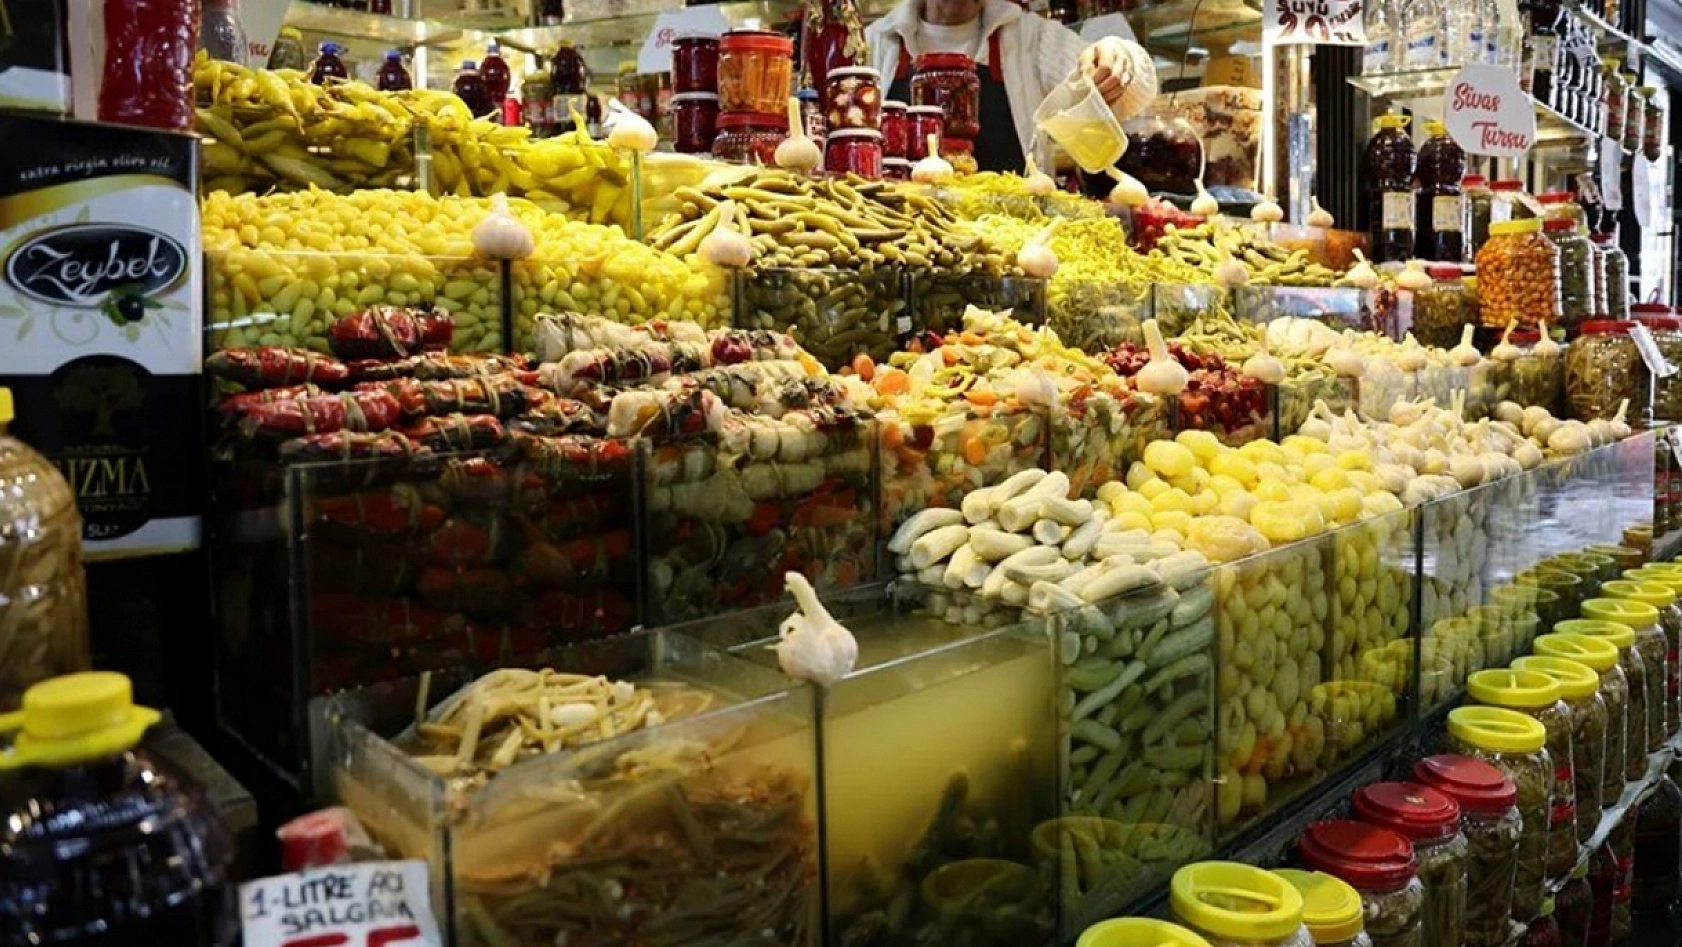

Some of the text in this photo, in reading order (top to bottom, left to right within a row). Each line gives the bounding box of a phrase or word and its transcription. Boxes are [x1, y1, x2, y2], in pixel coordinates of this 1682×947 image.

[1453, 82, 1501, 112] Sivas
[20, 153, 170, 181] extra virgin olive oil
[25, 236, 170, 299] Zeybek
